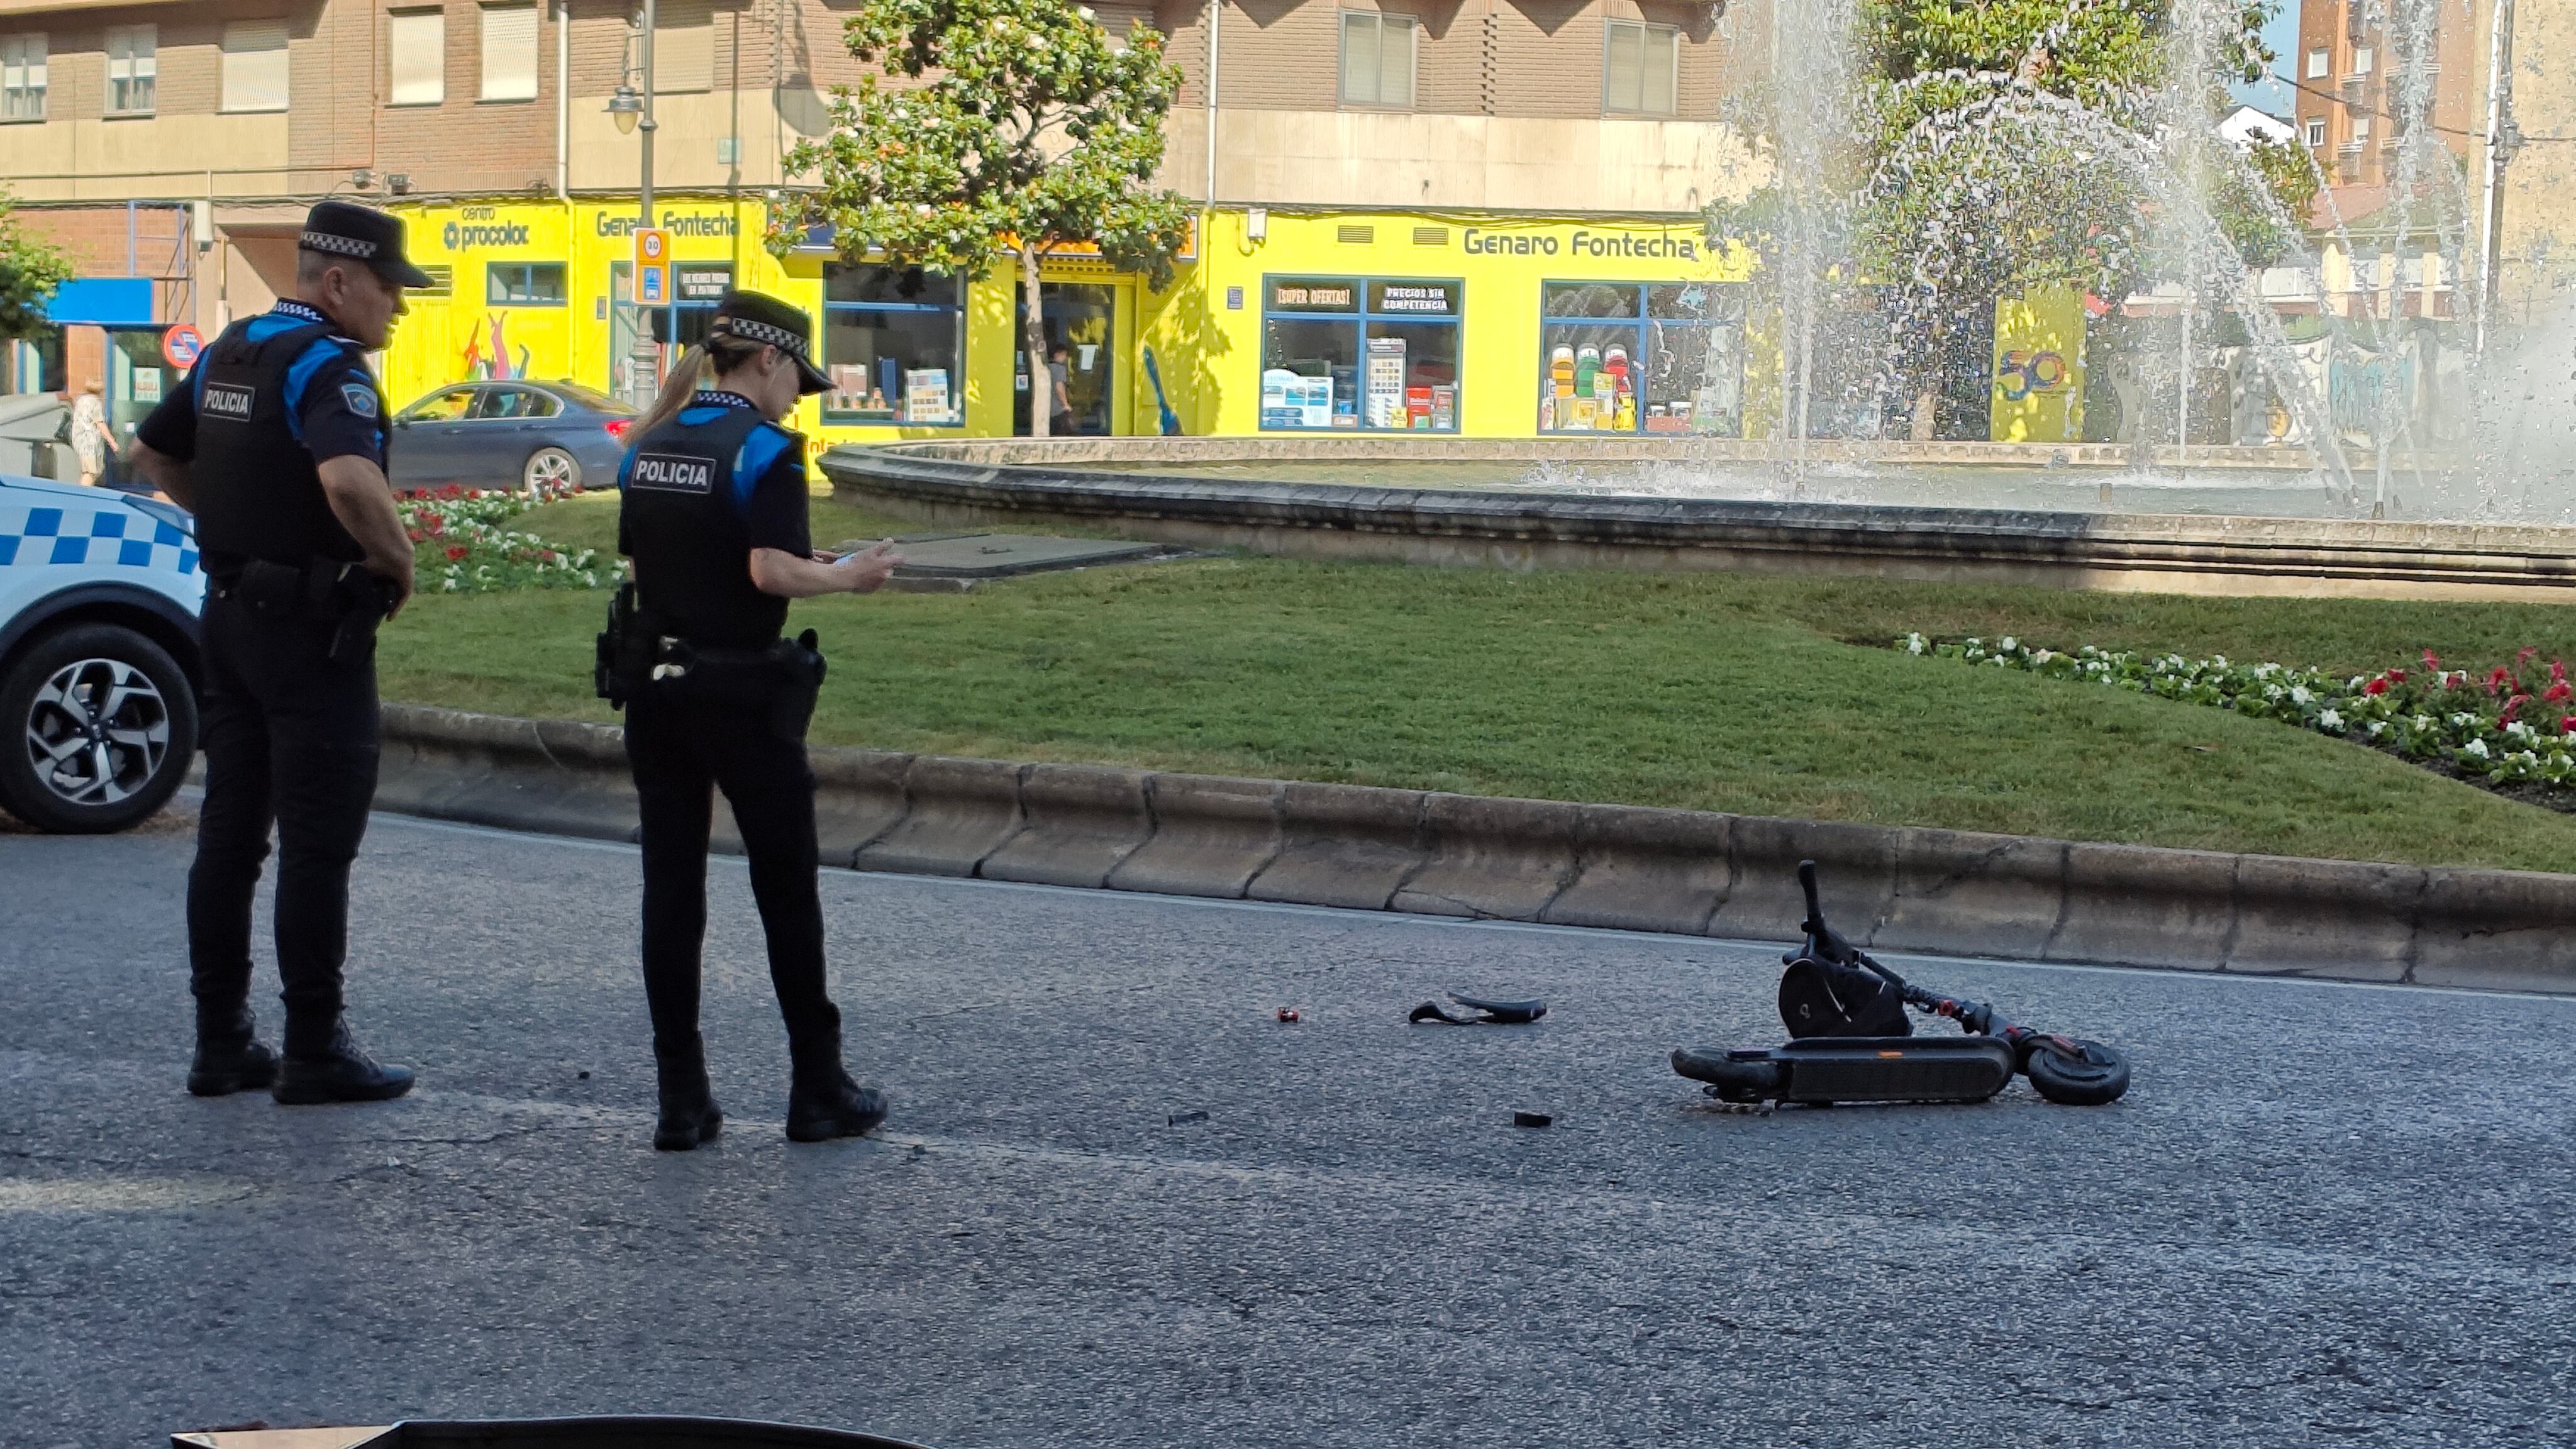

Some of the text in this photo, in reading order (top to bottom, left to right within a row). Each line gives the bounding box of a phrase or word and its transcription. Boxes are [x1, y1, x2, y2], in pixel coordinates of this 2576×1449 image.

[462, 208, 496, 221] centro
[597, 211, 655, 236] Gena
[462, 220, 529, 253] procolor
[1464, 228, 1694, 258] Genaro Fontecha
[1382, 299, 1448, 311] COMPETENCIA
[1386, 287, 1426, 299] PRECIOS
[204, 389, 249, 414] POLICIA
[635, 460, 708, 487] POLICIA
